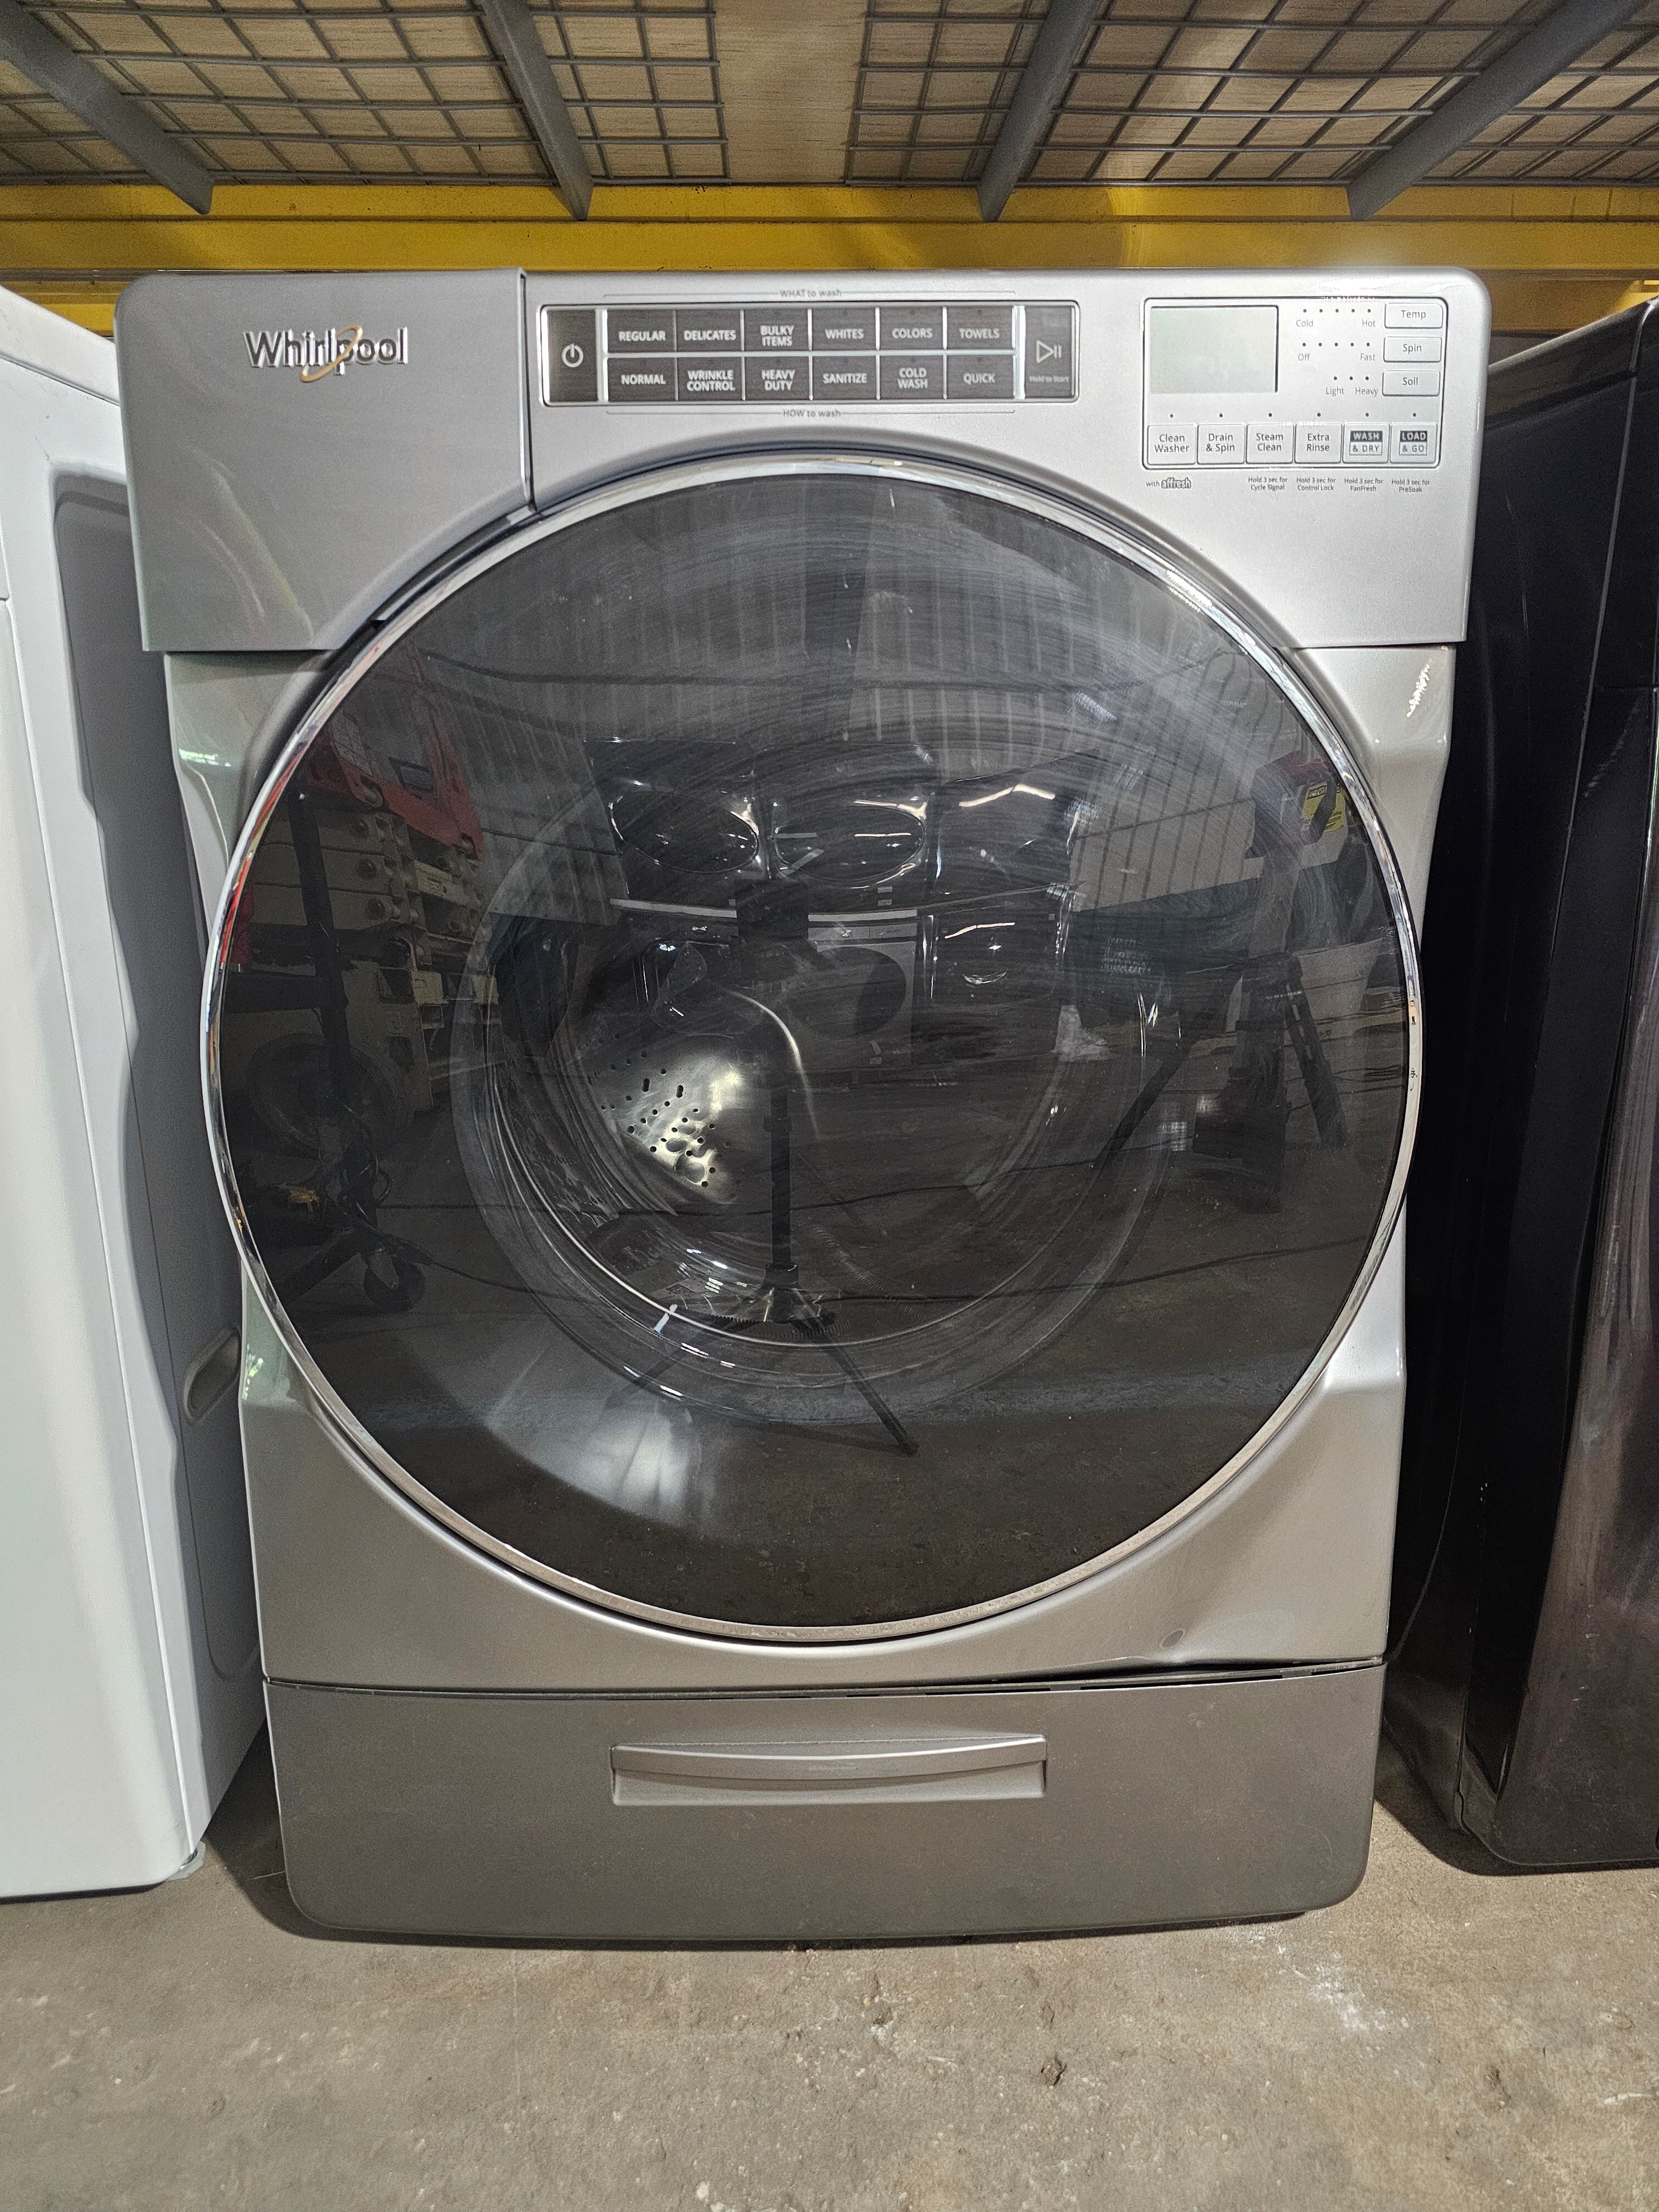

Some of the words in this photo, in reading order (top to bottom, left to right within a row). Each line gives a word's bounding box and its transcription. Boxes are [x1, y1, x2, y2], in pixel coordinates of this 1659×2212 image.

[819, 289, 842, 297] wash
[1401, 310, 1426, 320] Temp
[618, 330, 666, 341] REGULAR
[684, 330, 736, 341] DELICATES
[760, 325, 794, 336] BULKY
[825, 328, 864, 340] WHITES
[892, 328, 933, 338] COLORS
[959, 328, 999, 338] TOWELS
[762, 336, 792, 346] ITEMS
[244, 326, 408, 377] Whirlpool
[1402, 343, 1422, 354] Spin
[688, 370, 734, 380] WRINKLE
[762, 369, 795, 380] HEAVY
[899, 367, 927, 378] COLD
[620, 374, 666, 385] NORMAL
[823, 373, 867, 384] SANITIZE
[898, 378, 927, 389] WASH
[963, 373, 995, 384] QUICK
[1402, 377, 1418, 385] Soil
[687, 380, 735, 392] CONTROL
[765, 380, 792, 390] DUTY
[1326, 387, 1344, 397] Light
[1355, 387, 1378, 397] Heavy
[1159, 434, 1185, 442] Clean
[1208, 433, 1233, 441] Drain
[1256, 433, 1284, 441] Steam
[1307, 433, 1329, 441] Extra
[1353, 431, 1379, 440] WASH
[1402, 431, 1426, 440] LOAD
[1154, 444, 1190, 452] Washer
[1206, 444, 1213, 452] &
[1216, 444, 1235, 453] Spin
[1257, 443, 1282, 451] Clean
[1307, 444, 1330, 452] Rinse
[1161, 477, 1191, 489] affresh
